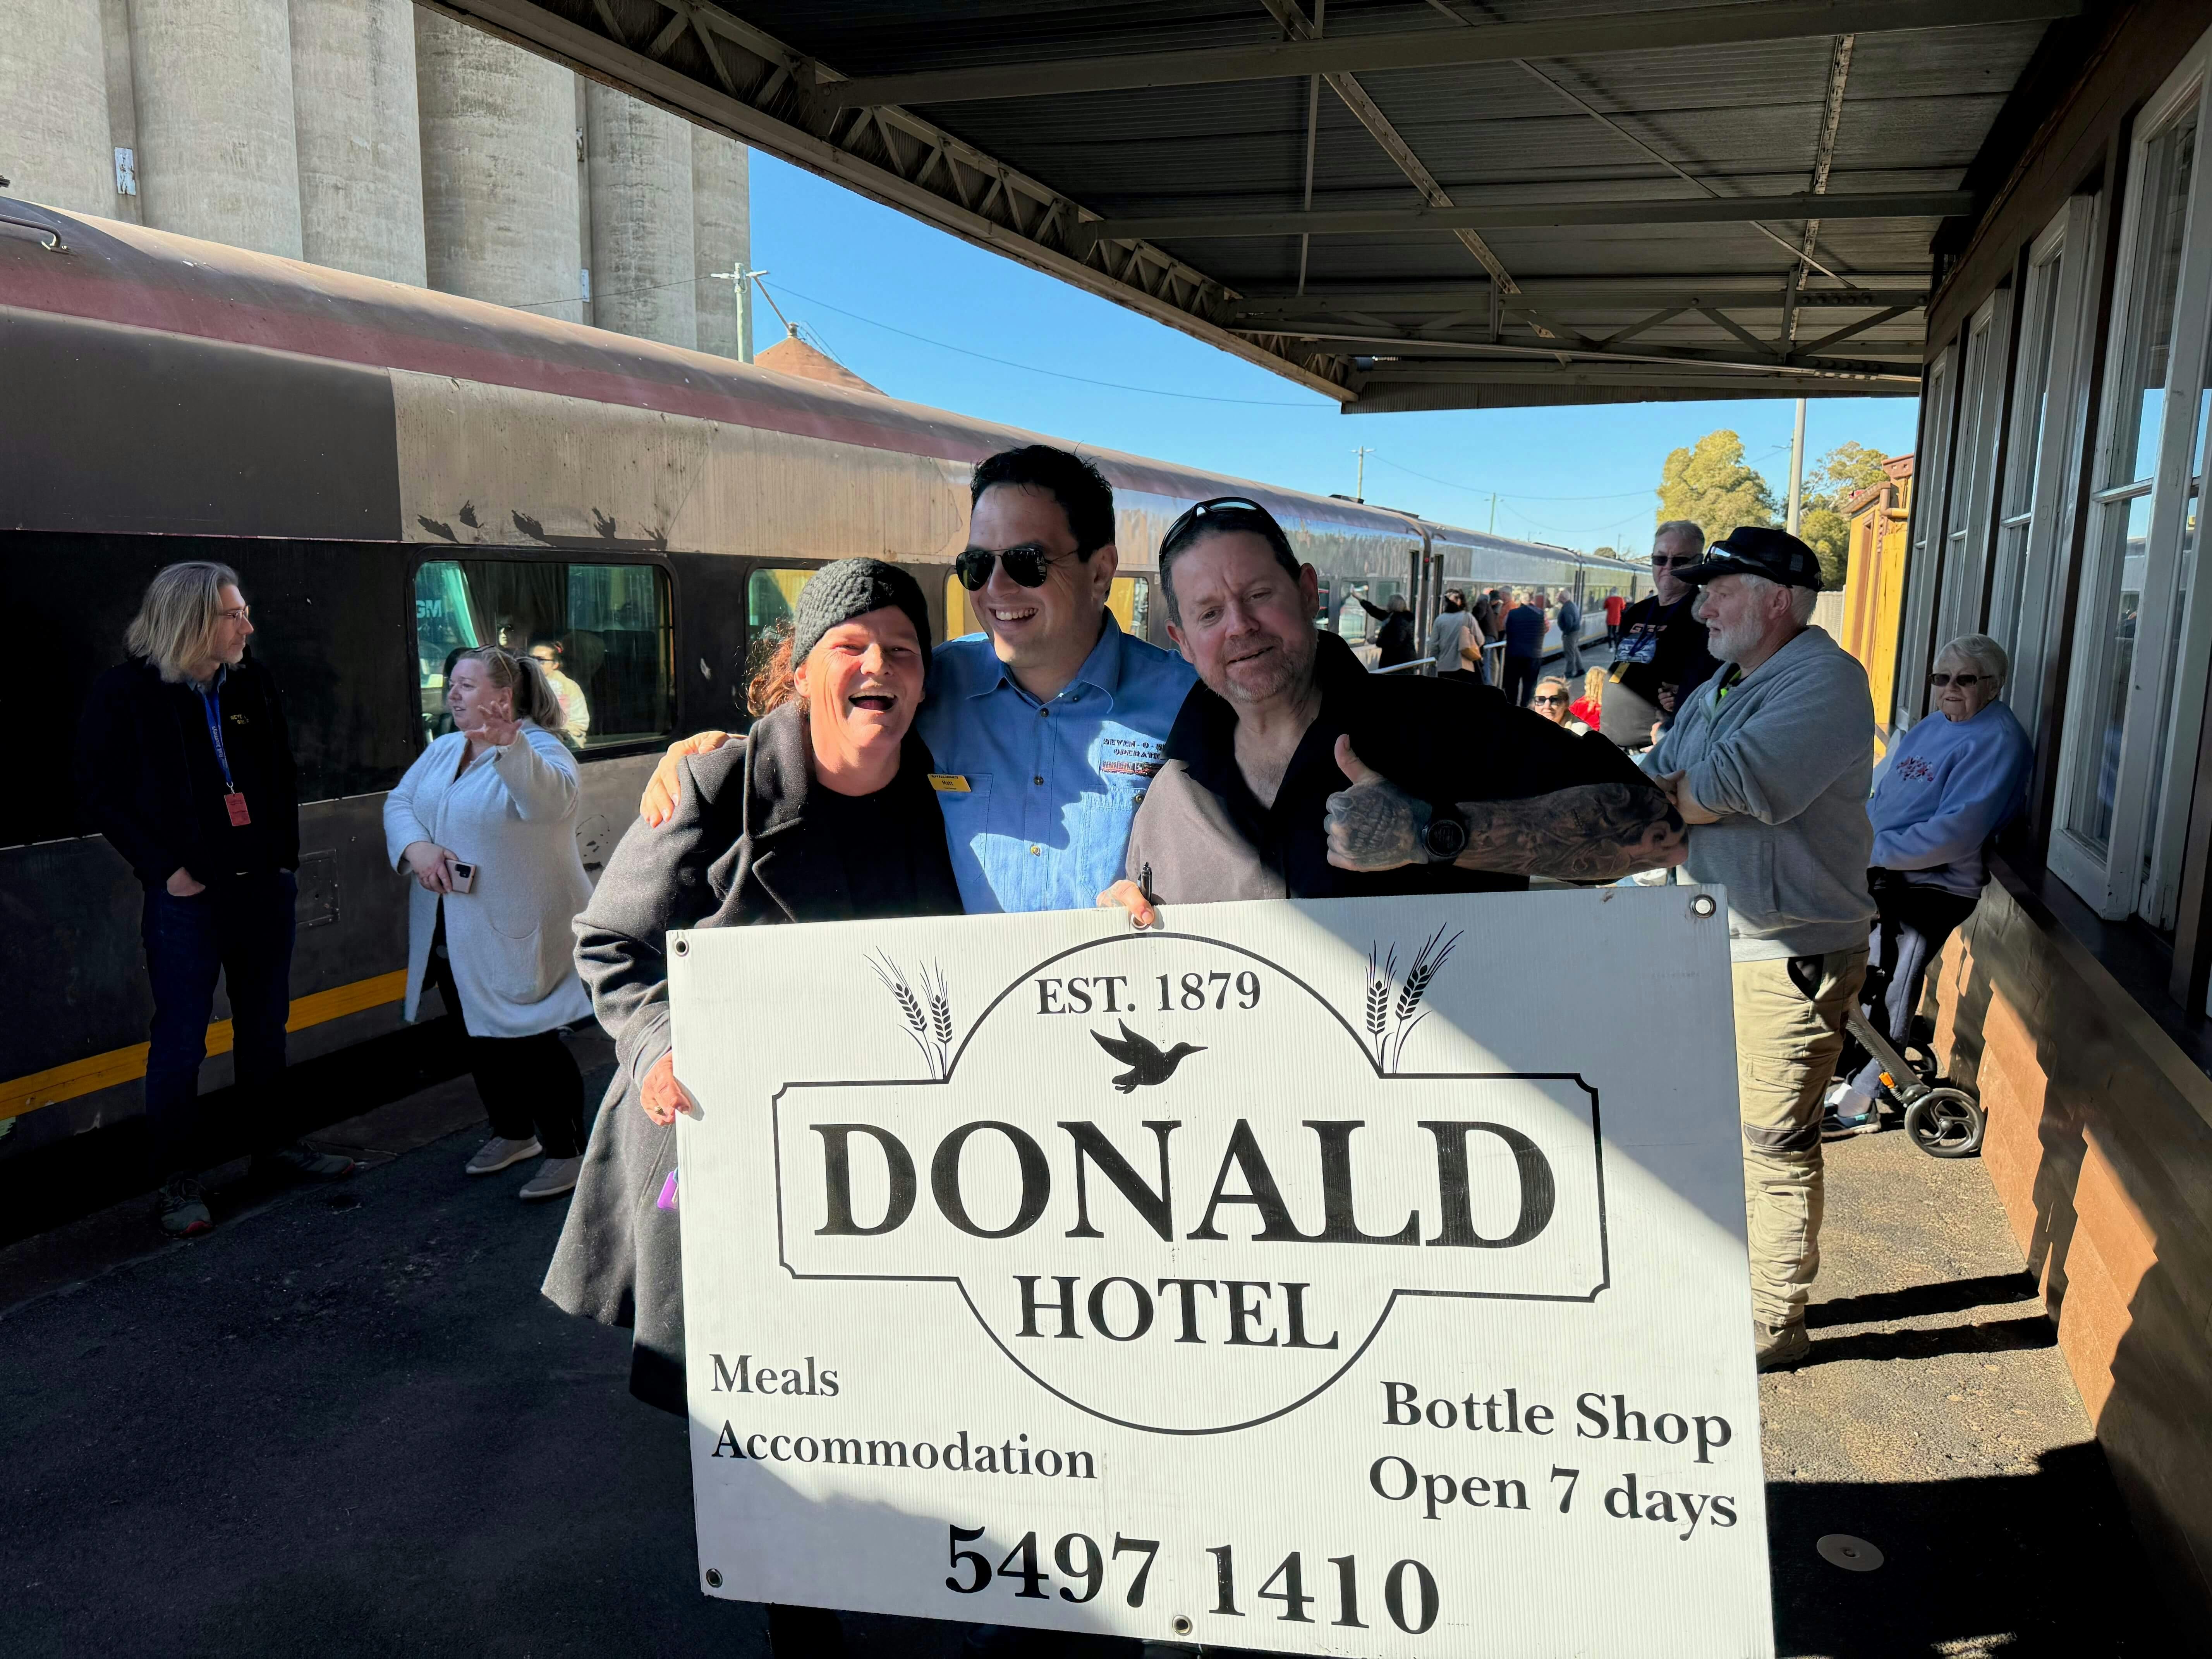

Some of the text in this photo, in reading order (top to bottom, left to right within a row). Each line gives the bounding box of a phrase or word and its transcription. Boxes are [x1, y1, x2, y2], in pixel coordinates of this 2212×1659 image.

[1034, 970, 1260, 1014] EST. 1879
[809, 1118, 1555, 1249] DONALD
[1012, 1275, 1338, 1350] HOTEL
[709, 1354, 840, 1396] Meals
[711, 1419, 1098, 1479] Accommodation
[1380, 1381, 1732, 1464] Bottle Shop
[1370, 1456, 1737, 1541] Open 7 days
[945, 1523, 1439, 1635] 5497 1410
